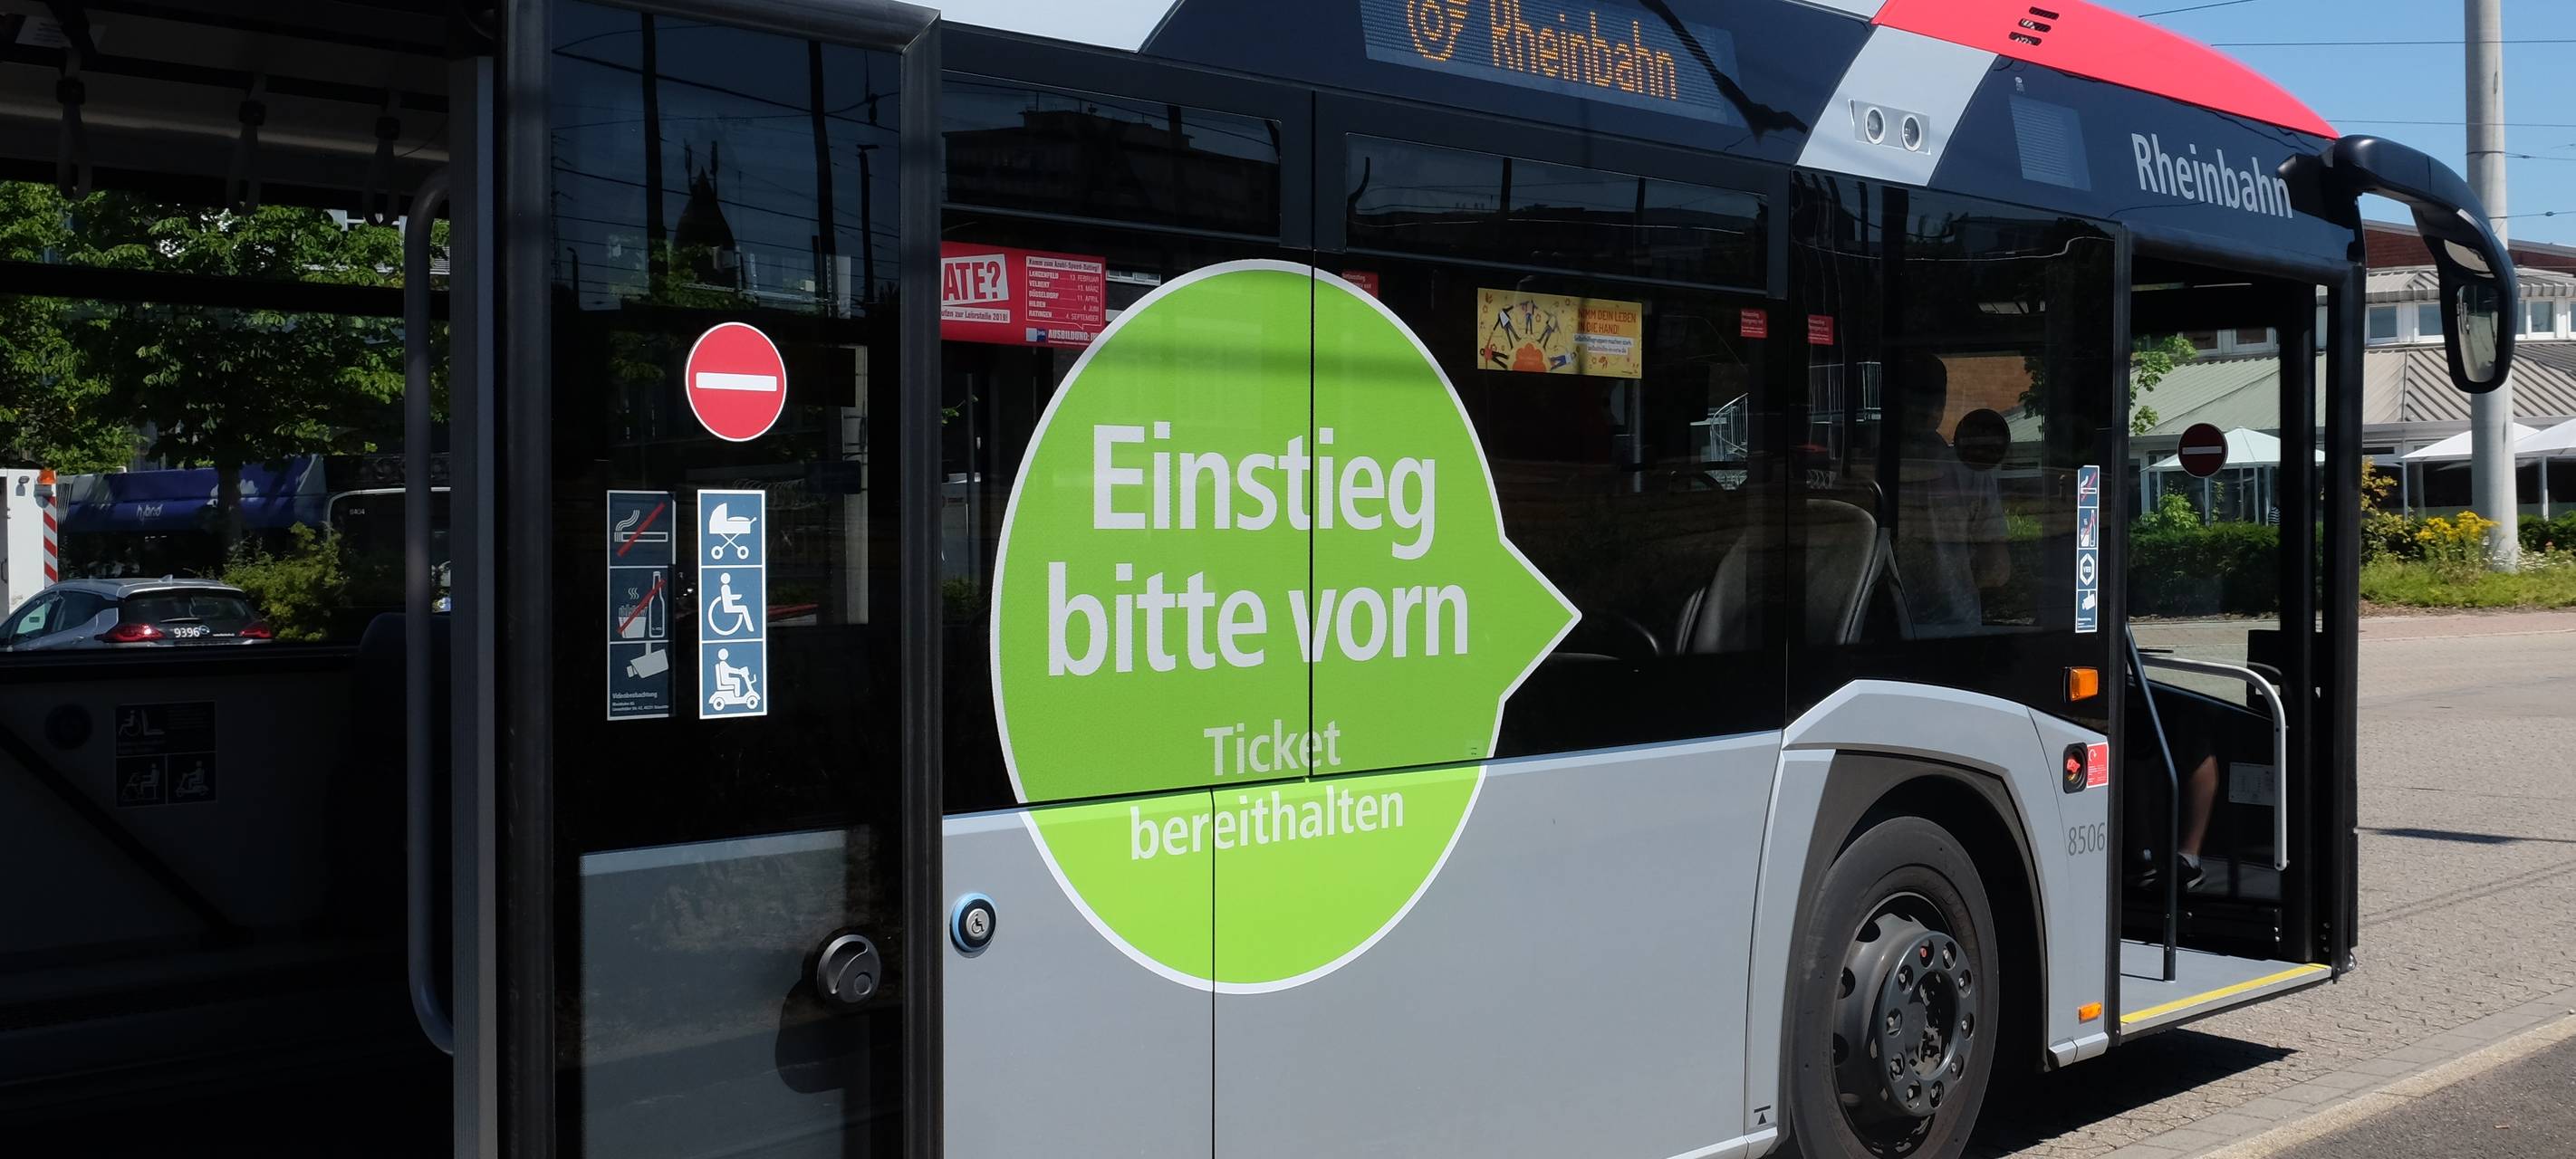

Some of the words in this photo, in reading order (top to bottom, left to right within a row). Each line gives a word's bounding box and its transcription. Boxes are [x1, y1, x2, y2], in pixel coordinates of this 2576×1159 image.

[1491, 0, 1677, 100] Rheinbahn
[2131, 133, 2293, 218] Rheinbahn
[943, 261, 1001, 301] ATE?
[1093, 421, 1436, 560] Einstieg
[174, 627, 200, 638] 9396
[1048, 561, 1267, 676] bitte
[1288, 585, 1468, 663] vorn
[1204, 719, 1341, 776] Ticket
[1130, 785, 1403, 860] bereithalten
[2068, 822, 2106, 856] 8506
